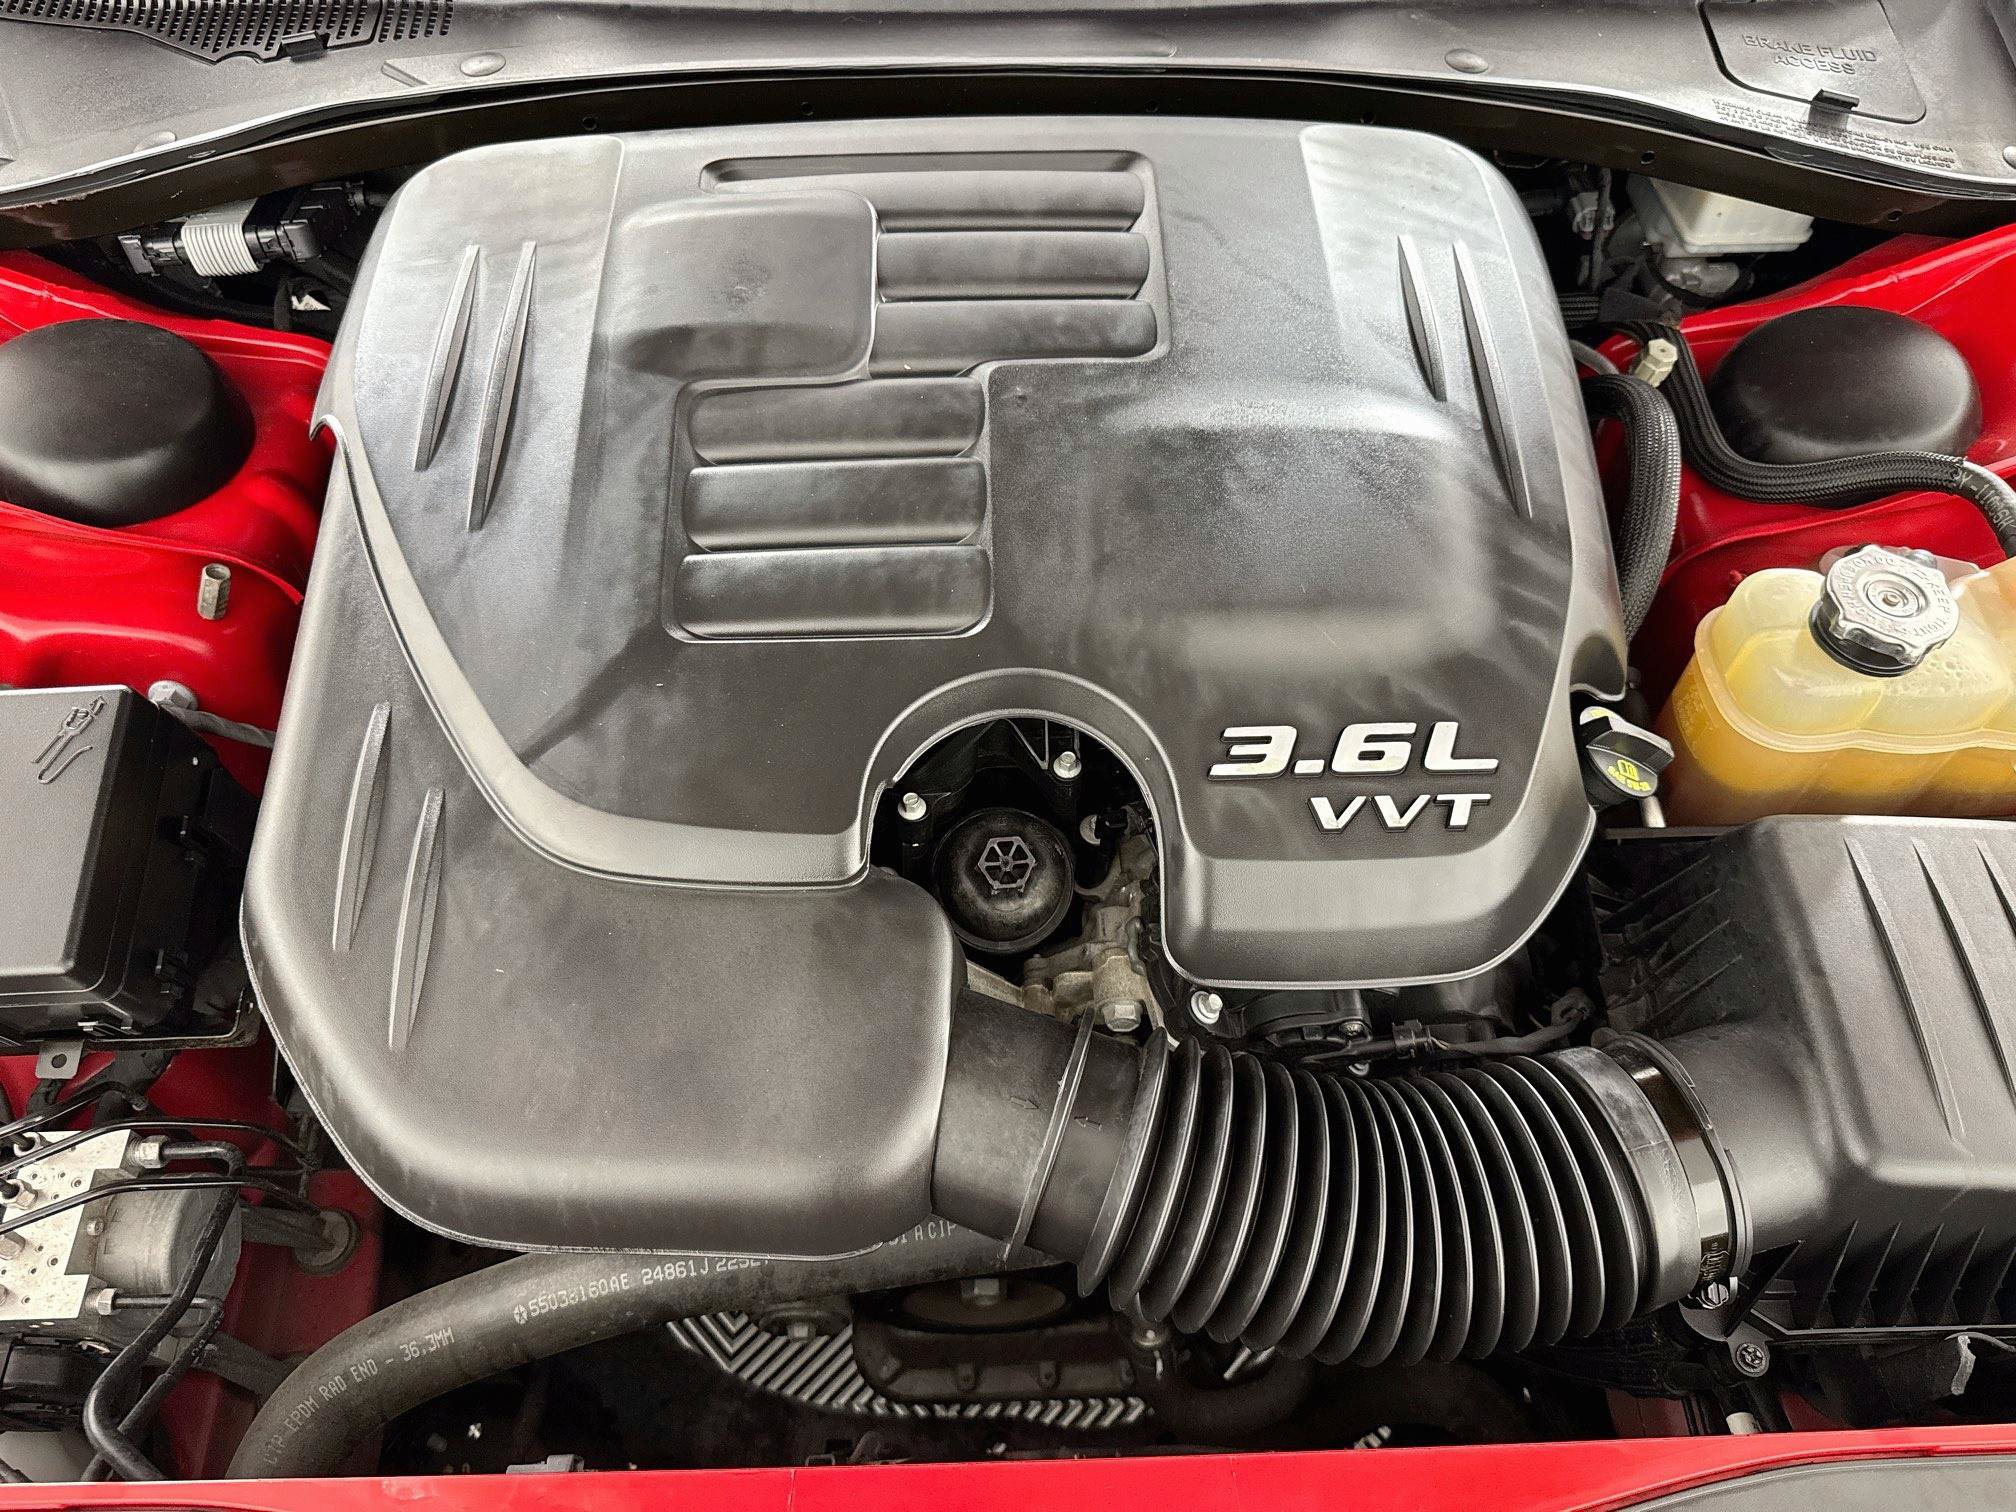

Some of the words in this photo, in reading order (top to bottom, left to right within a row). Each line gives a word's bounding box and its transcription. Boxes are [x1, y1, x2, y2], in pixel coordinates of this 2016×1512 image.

[1741, 34, 1815, 56] BRAKE
[1816, 45, 1878, 62] FLUID
[1773, 55, 1856, 75] ACCESS
[1208, 721, 1499, 780] 3.6L
[1308, 793, 1492, 833] VVT
[283, 1394, 321, 1432] EPDM
[318, 1374, 348, 1402] RAD
[350, 1358, 379, 1384] END
